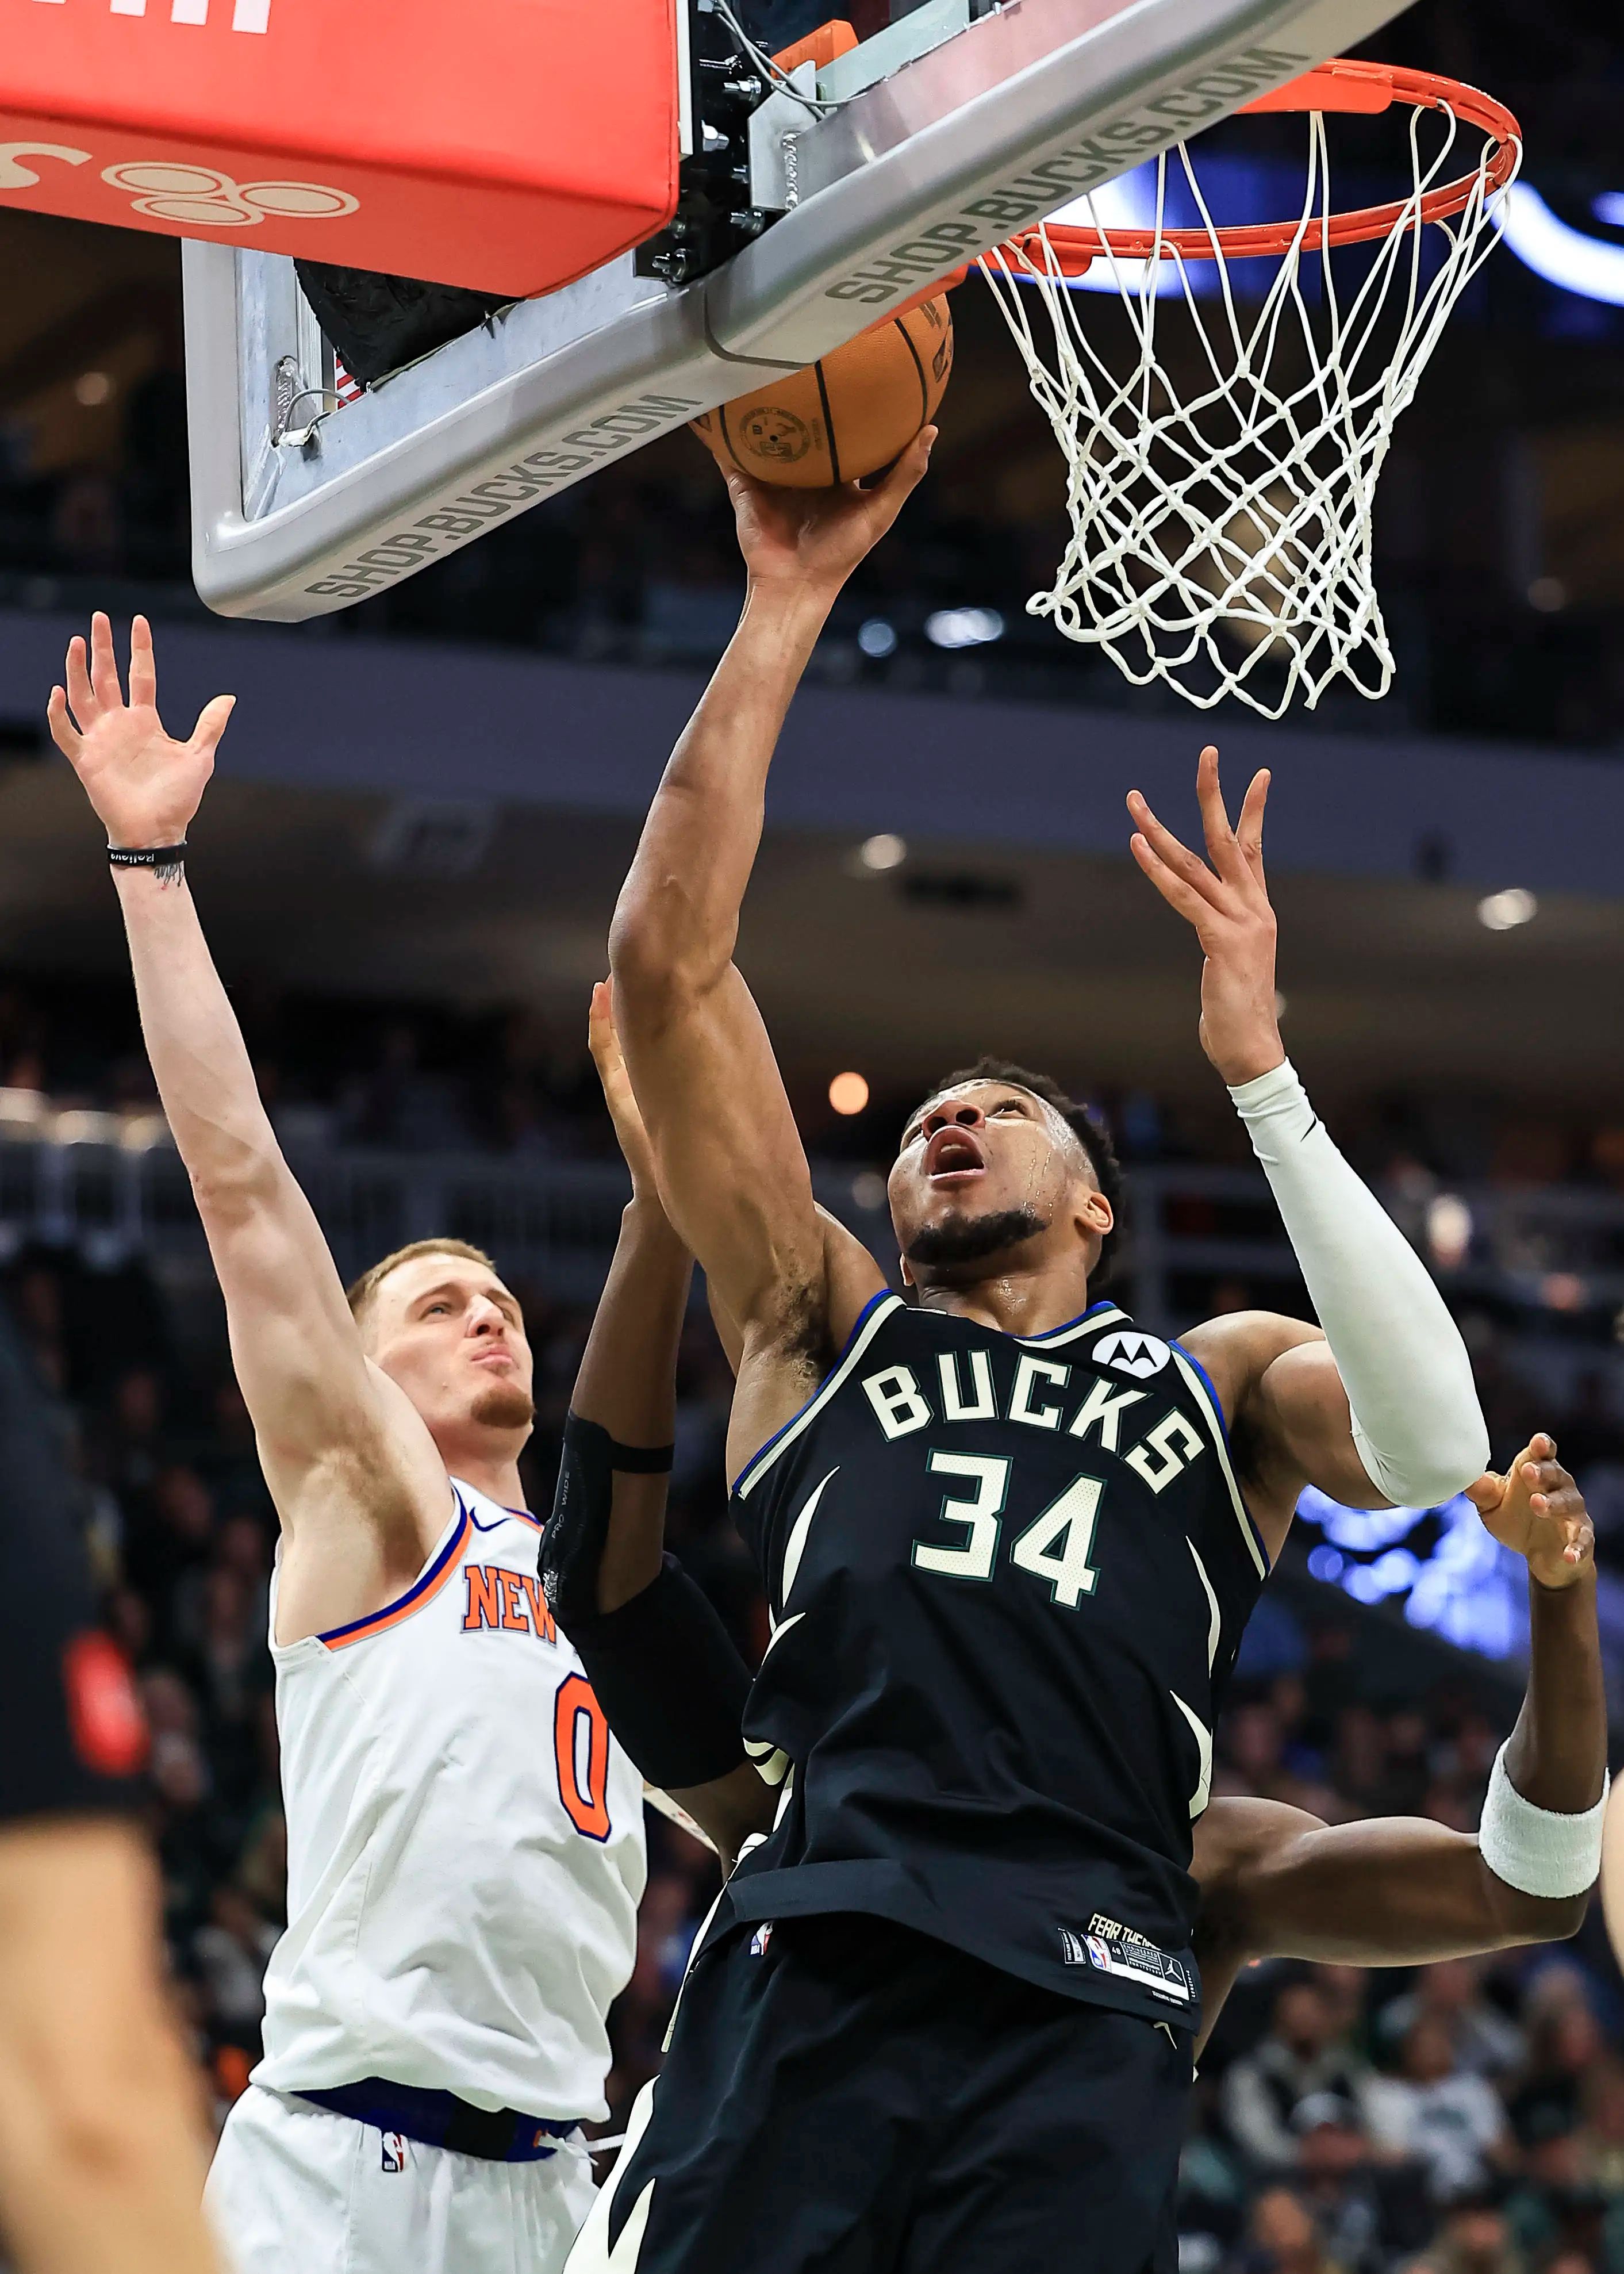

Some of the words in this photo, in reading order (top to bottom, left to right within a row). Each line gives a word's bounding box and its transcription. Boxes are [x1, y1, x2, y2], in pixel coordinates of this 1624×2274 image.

[825, 48, 1312, 304] SHOP.BUCKS.COM
[304, 394, 704, 599] SHOP.BUCKS.COM
[859, 1349, 1207, 1497] BUCKS
[551, 1513, 565, 1539] PRO
[561, 1471, 570, 1506] WIDE
[911, 1448, 1108, 1611] 34
[461, 1564, 558, 1648] NEW
[553, 1670, 612, 1843] 0
[1088, 1913, 1123, 1940] FEAR
[1111, 1946, 1122, 1955] 48
